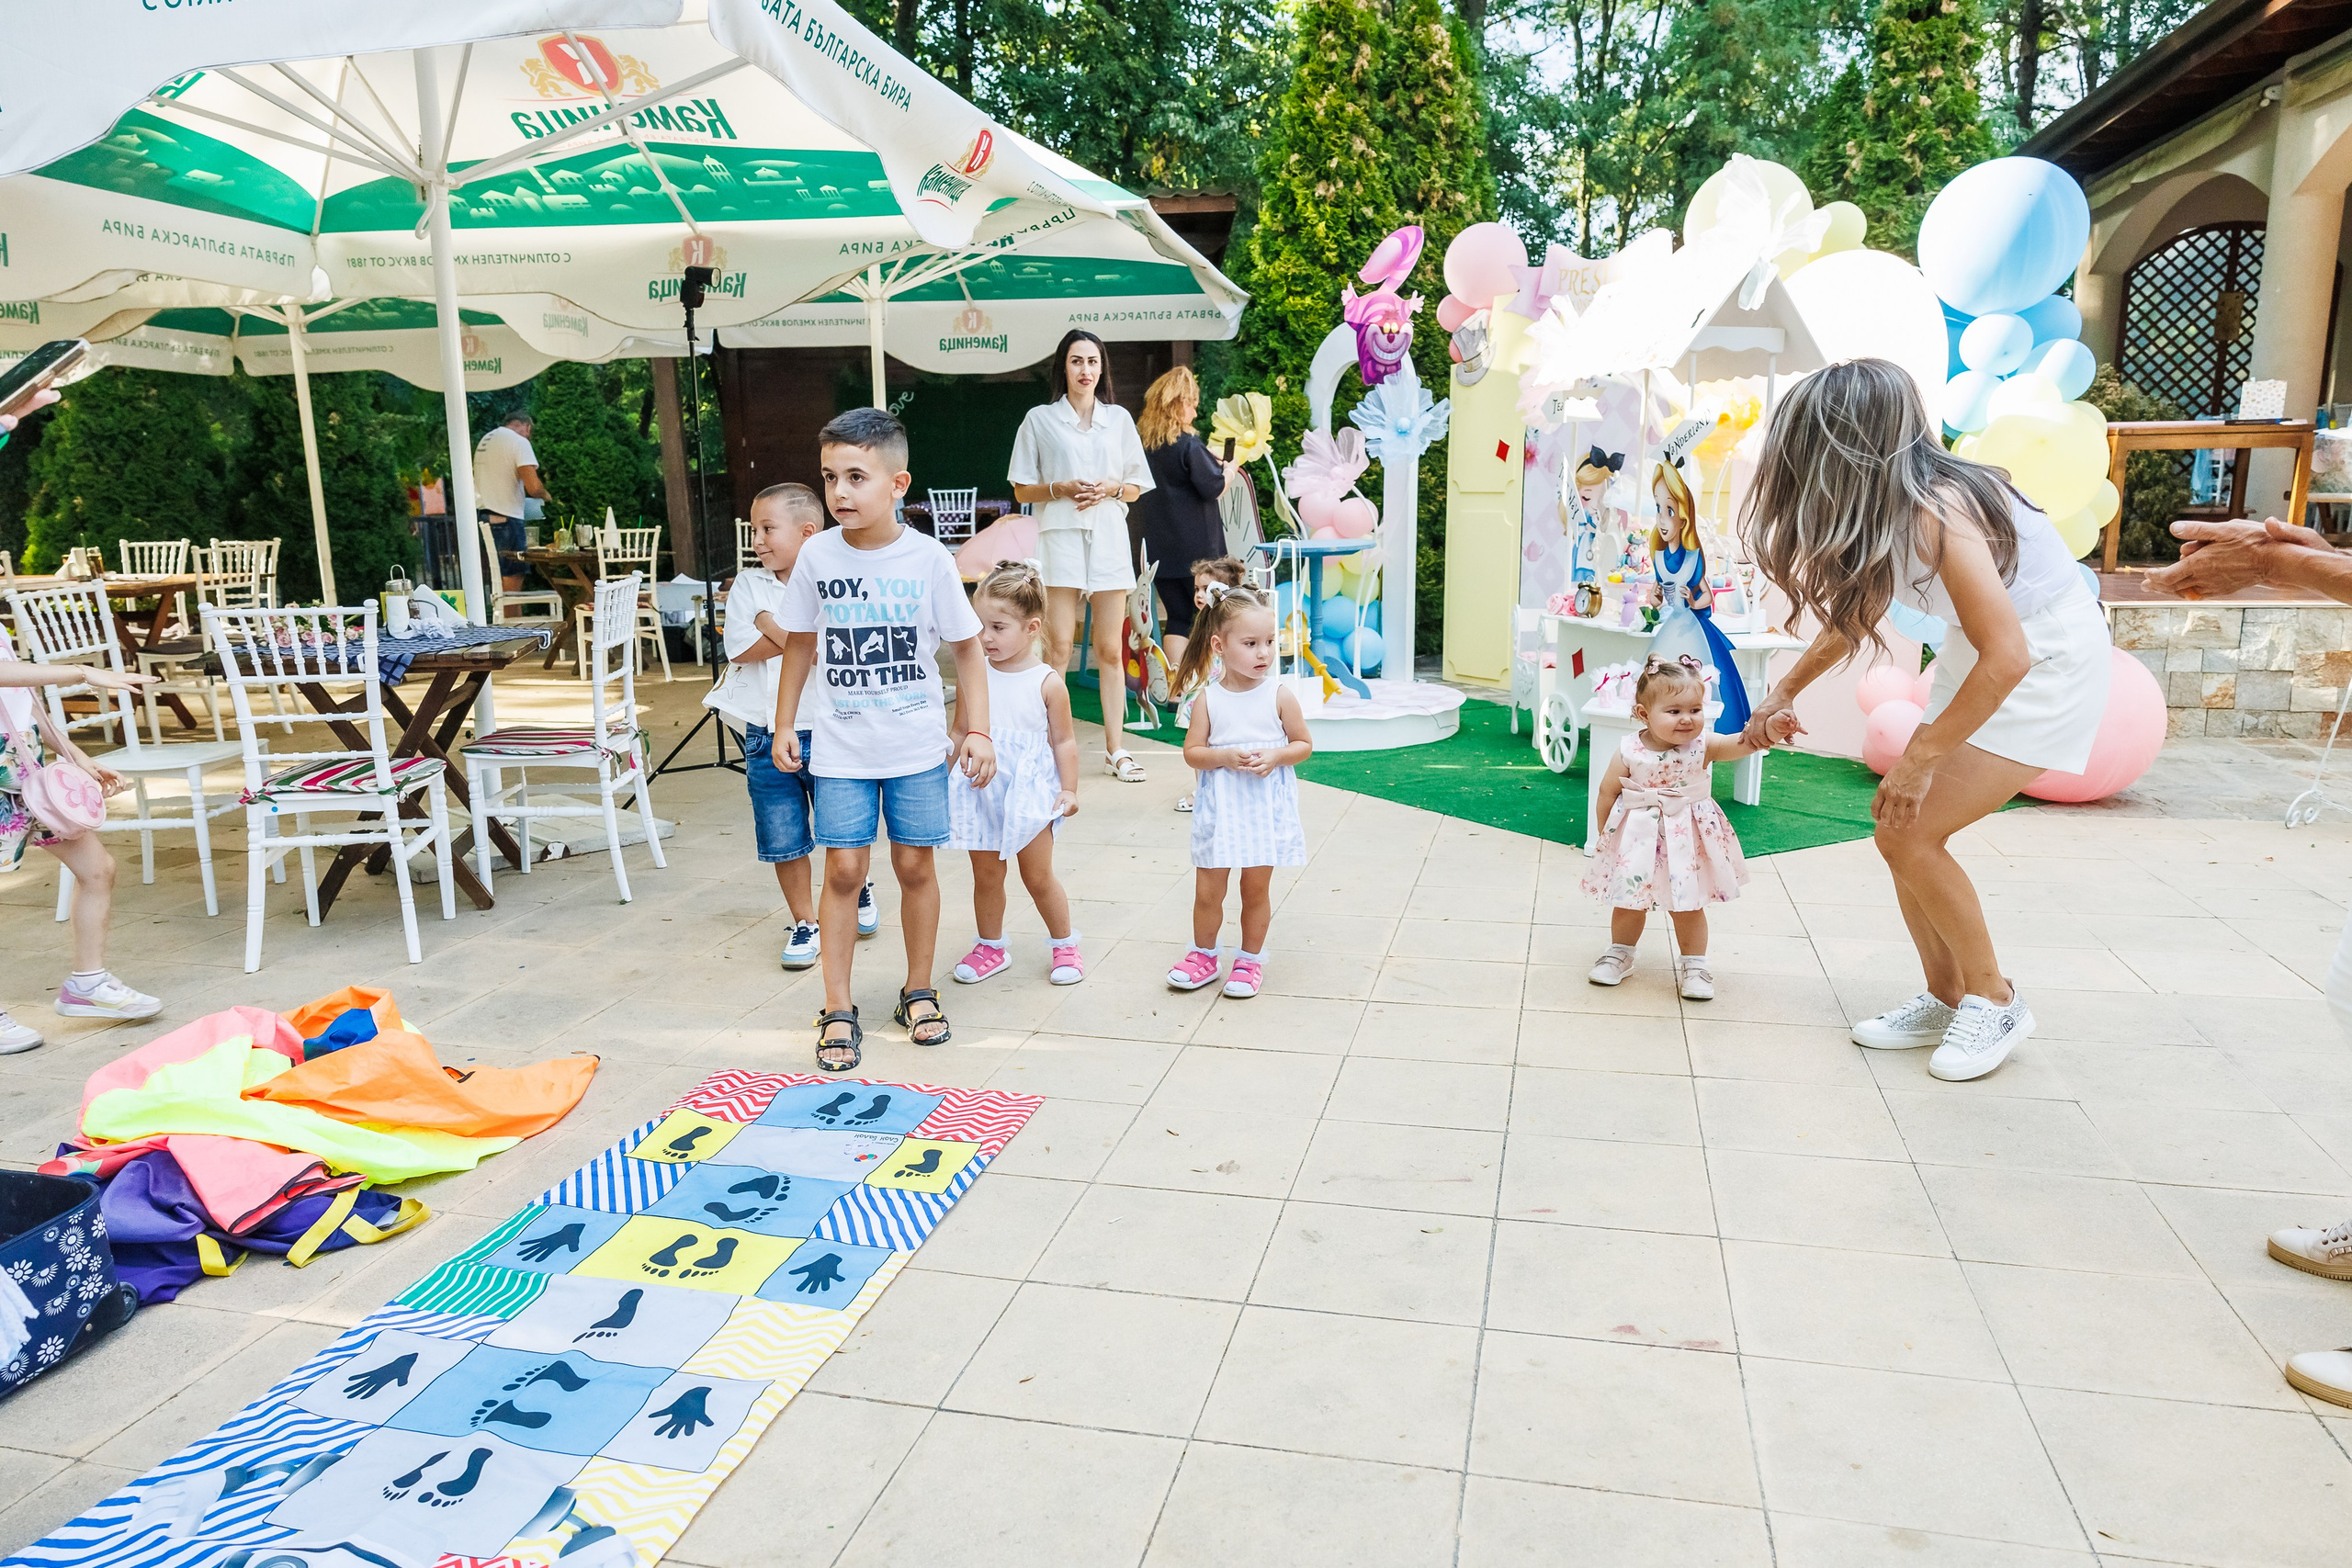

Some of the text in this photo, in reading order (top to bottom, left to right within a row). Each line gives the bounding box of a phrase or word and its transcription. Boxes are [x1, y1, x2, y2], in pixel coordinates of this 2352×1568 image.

[803, 17, 880, 90] БЪЛГАРСКА
[880, 74, 912, 112] БИРА
[916, 163, 973, 206] Каменица
[817, 577, 925, 601] BOY, YOU
[823, 602, 921, 624] TOTALLY
[826, 663, 926, 687] GOT THIS
[853, 698, 870, 708] DO
[872, 696, 894, 707] THE
[864, 688, 889, 696] YOURSELF
[890, 684, 909, 693] PROUD
